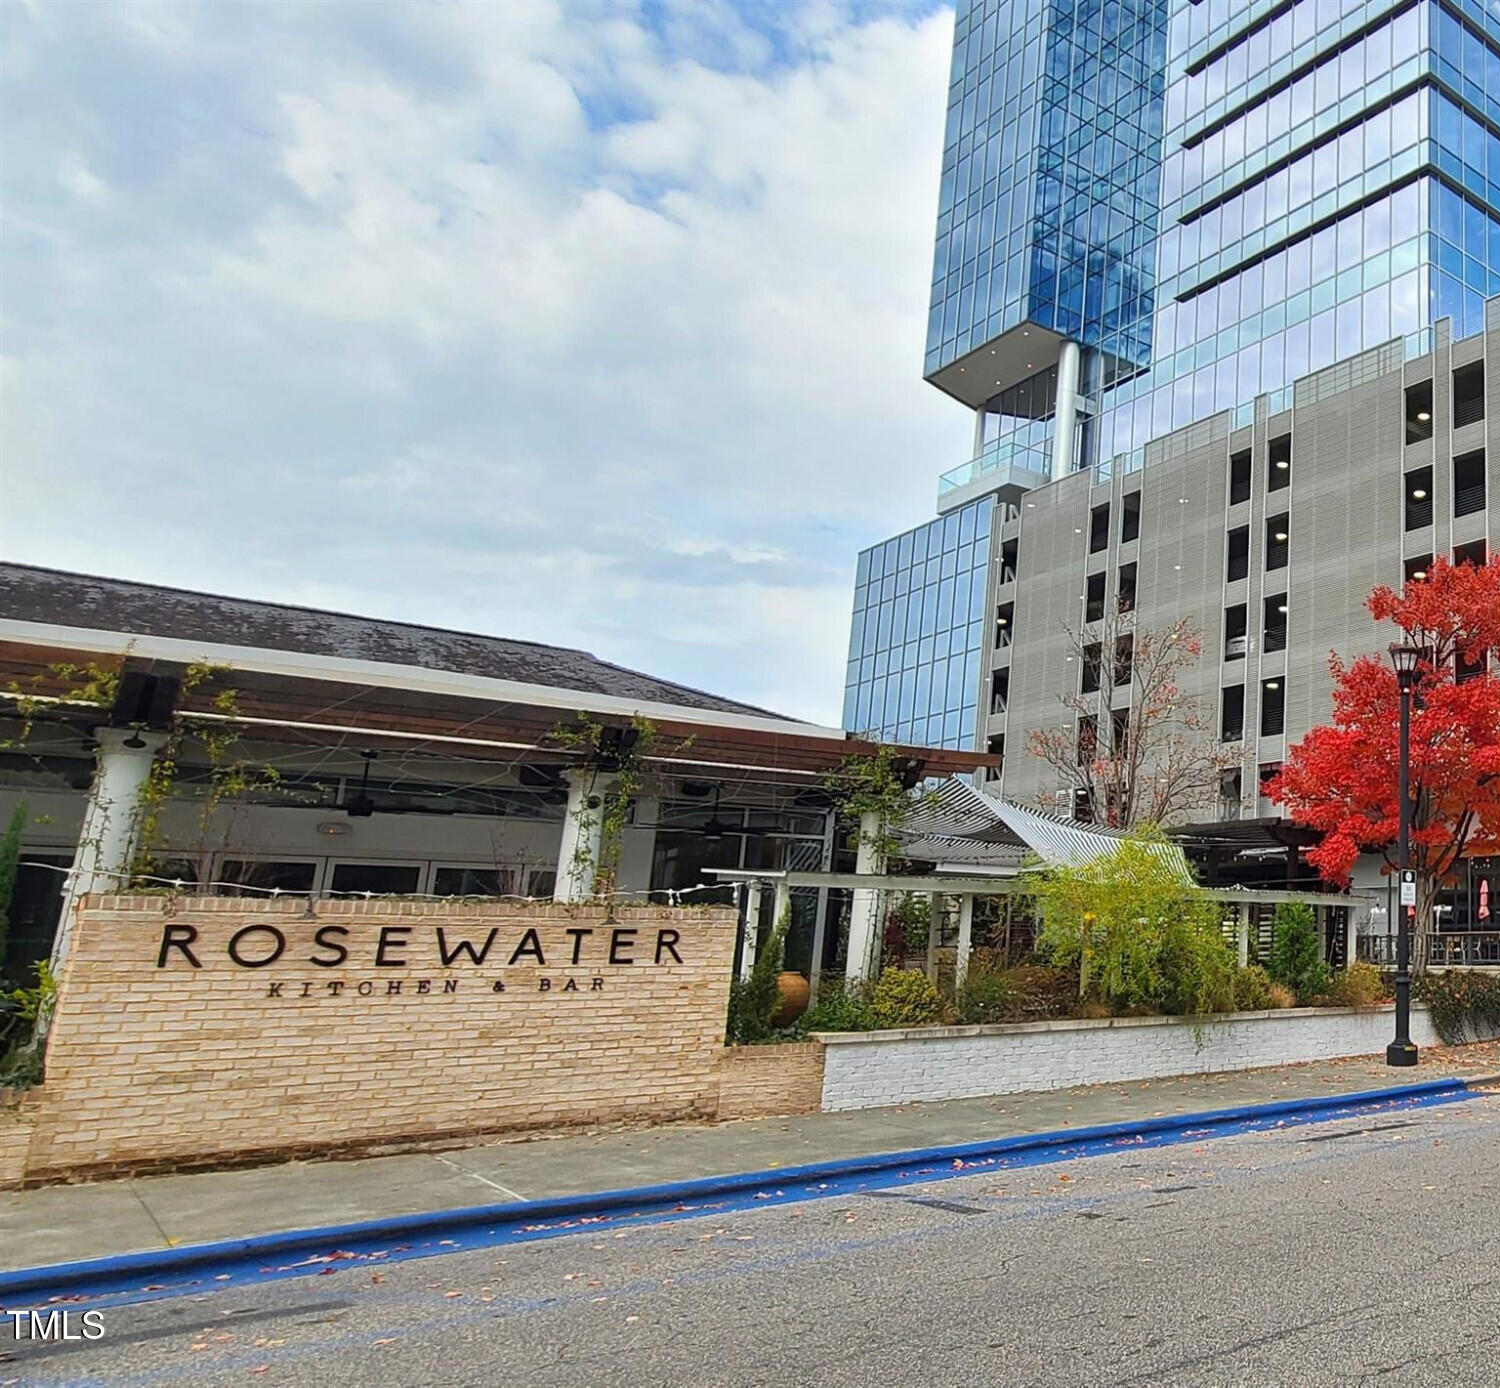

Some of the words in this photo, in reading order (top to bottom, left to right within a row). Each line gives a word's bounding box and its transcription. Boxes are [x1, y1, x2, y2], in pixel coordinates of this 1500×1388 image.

[157, 924, 684, 968] ROSEWATER
[266, 980, 458, 998] KITCHEN
[492, 980, 505, 992] &
[538, 977, 604, 992] BAR
